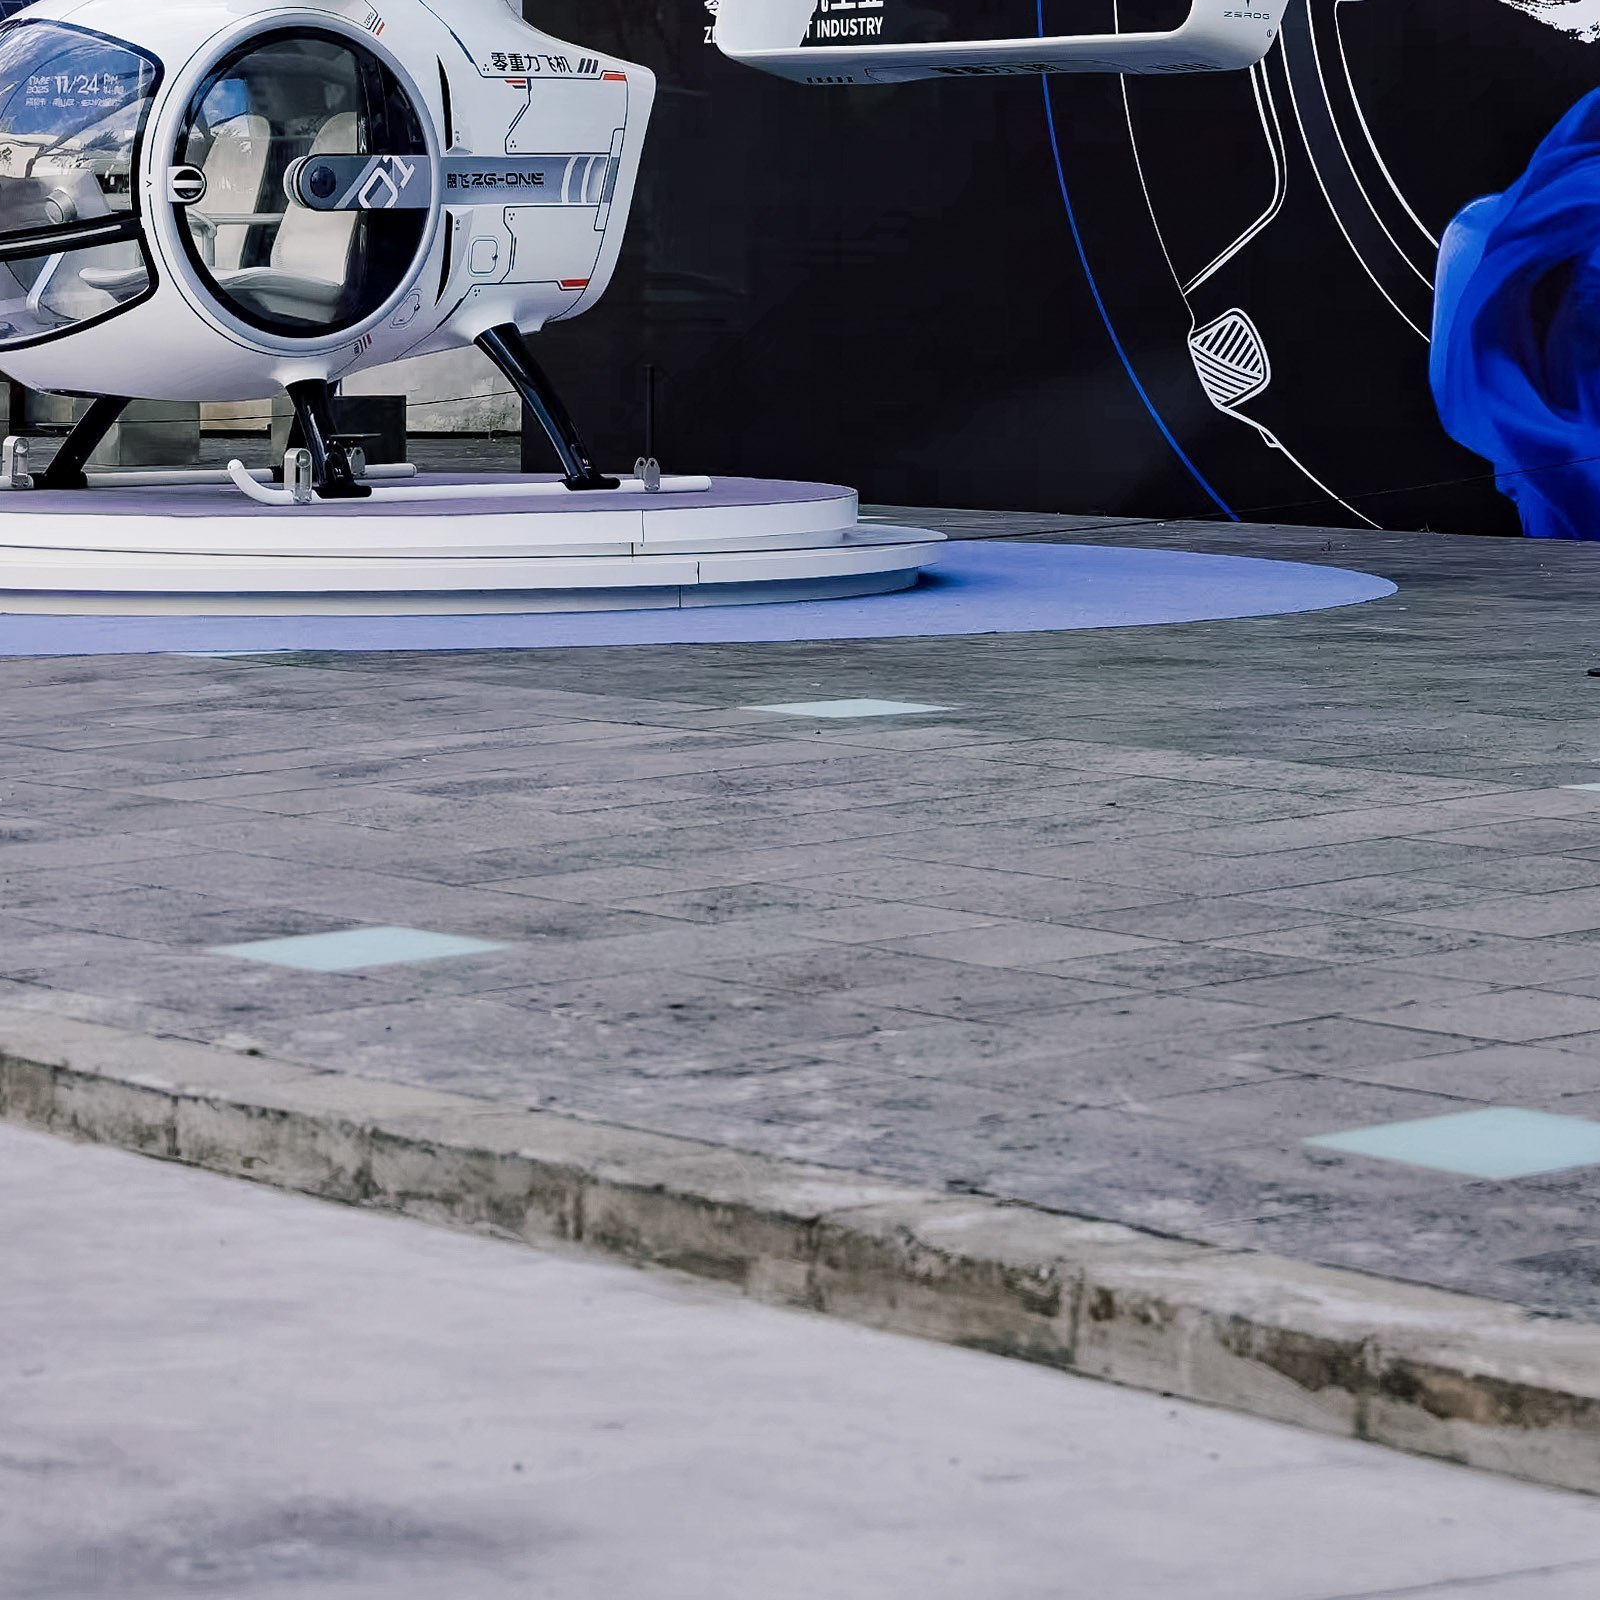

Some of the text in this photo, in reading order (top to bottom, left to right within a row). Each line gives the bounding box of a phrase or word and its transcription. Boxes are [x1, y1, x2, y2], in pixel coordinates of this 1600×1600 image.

[1223, 11, 1270, 20] ZEROG
[816, 16, 884, 39] INDUSTRY
[491, 52, 573, 74] 零重力飞机
